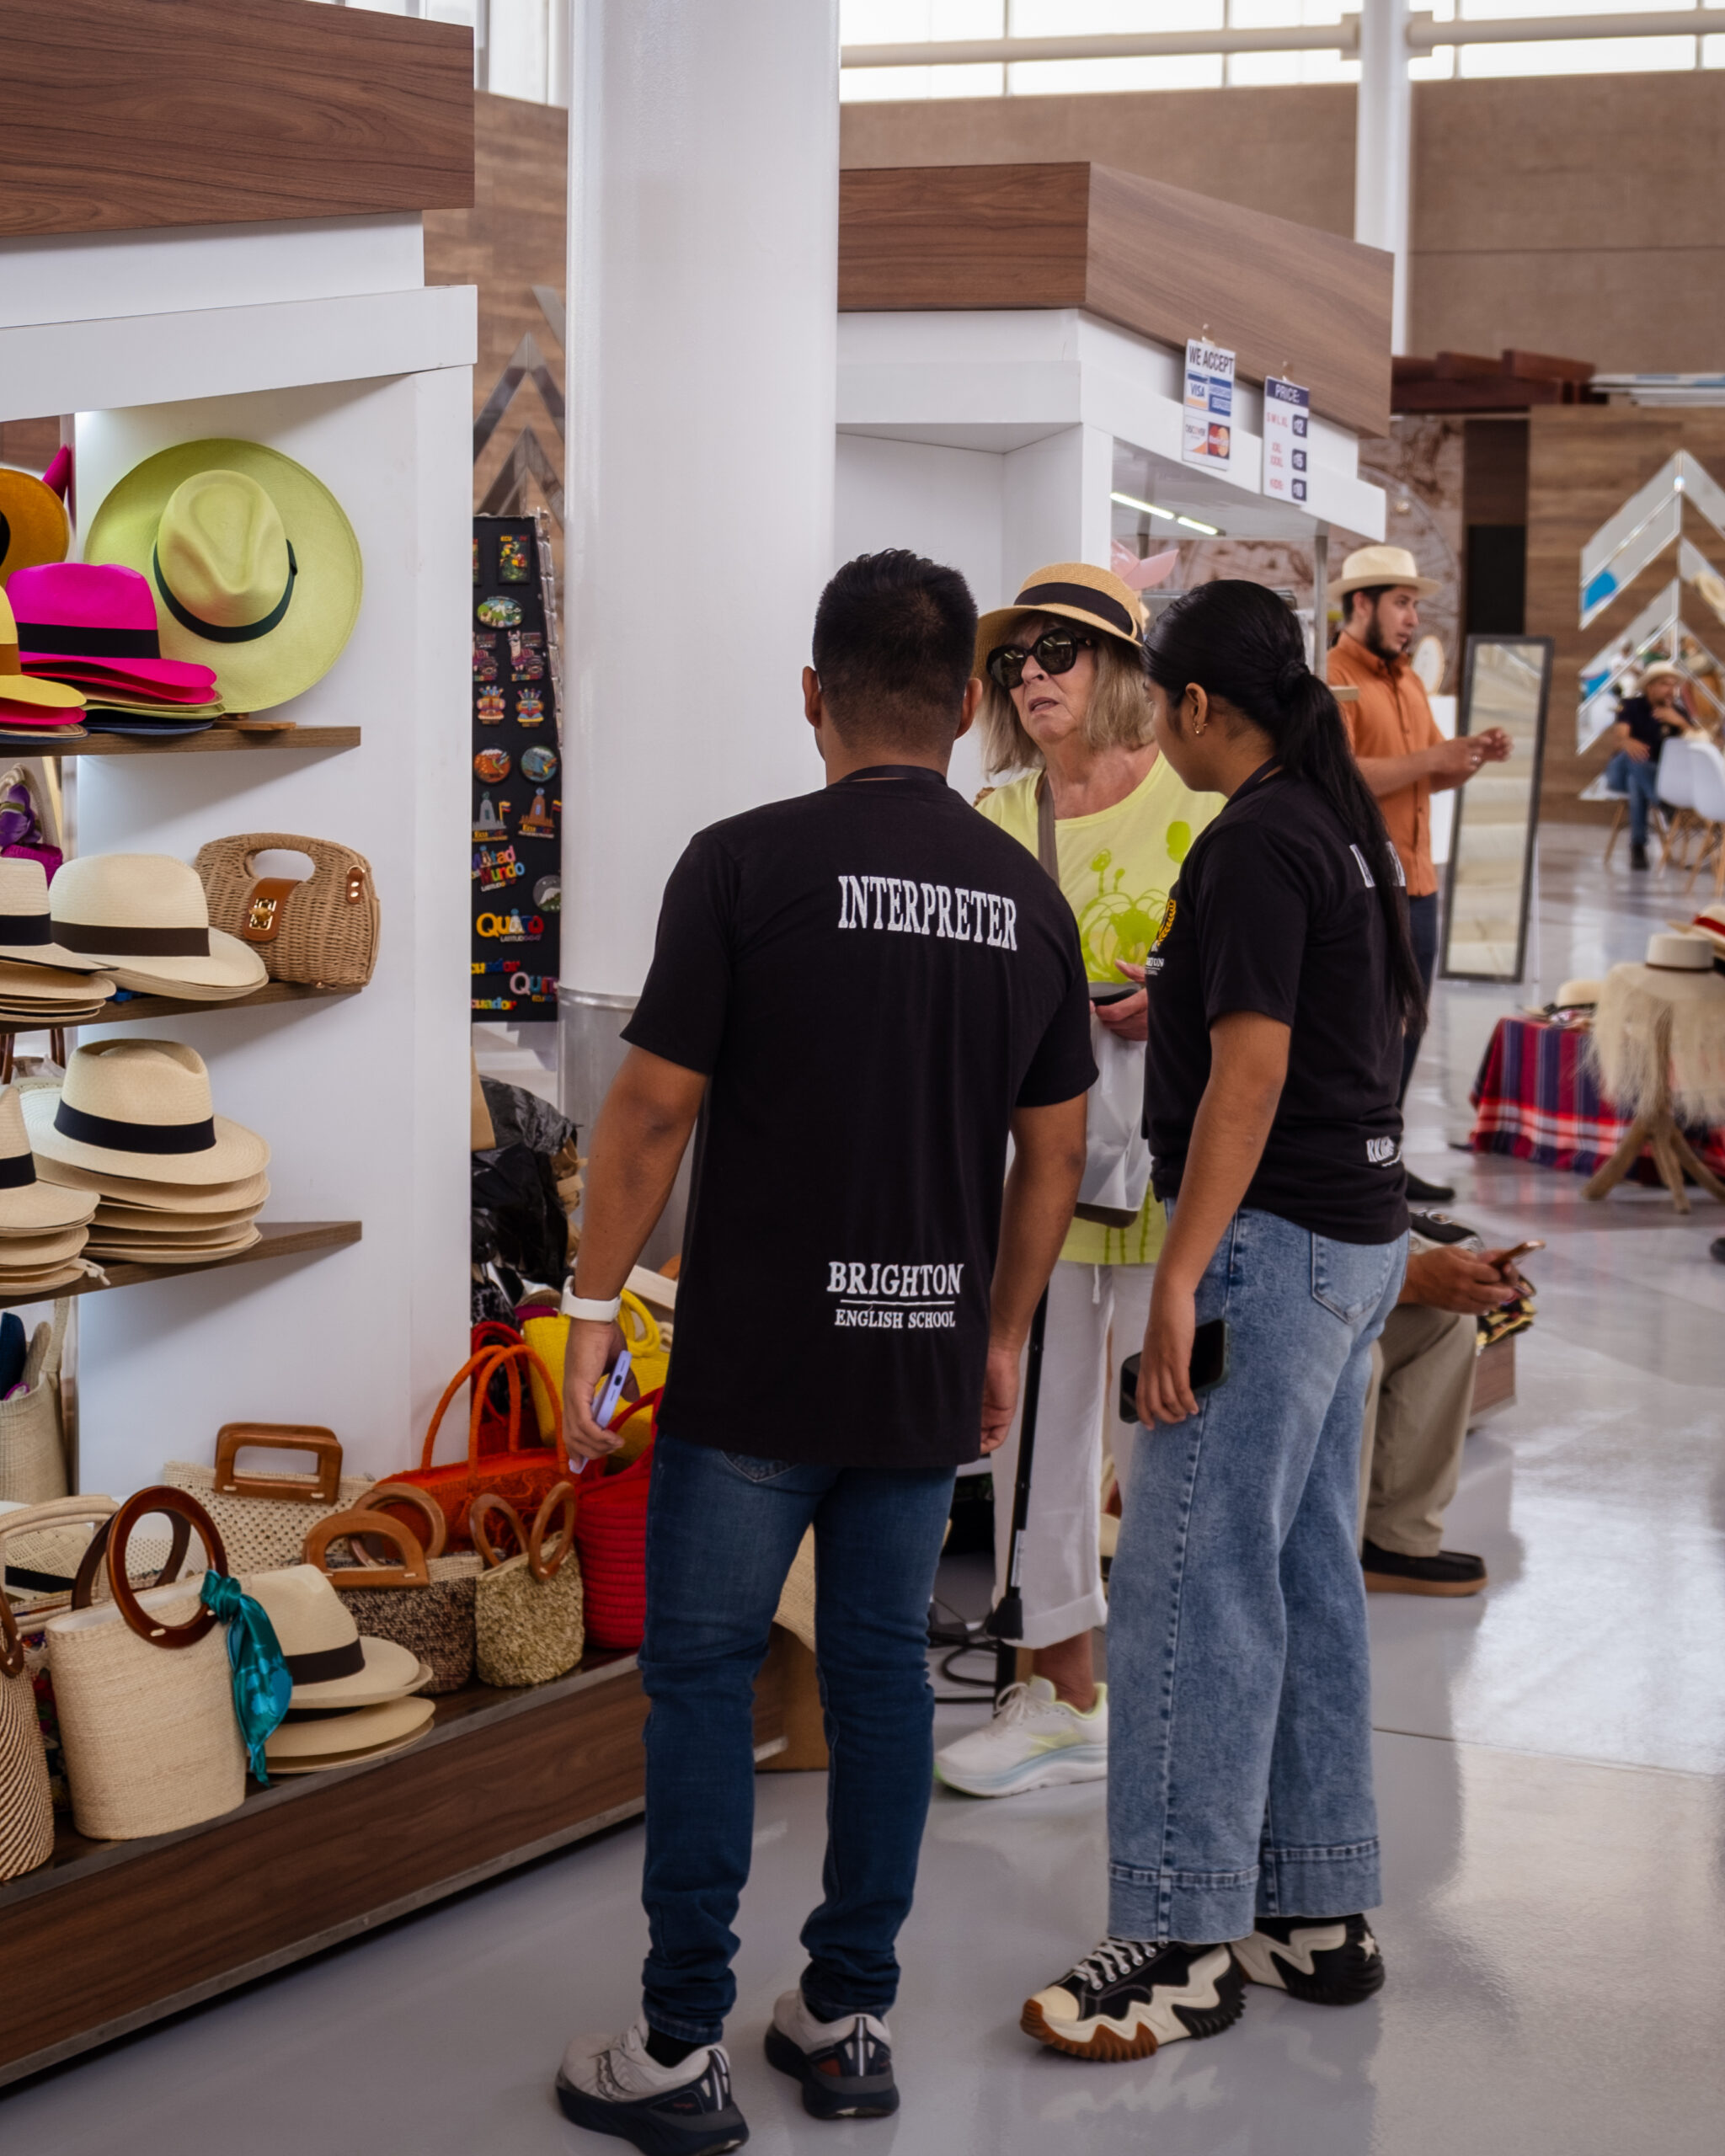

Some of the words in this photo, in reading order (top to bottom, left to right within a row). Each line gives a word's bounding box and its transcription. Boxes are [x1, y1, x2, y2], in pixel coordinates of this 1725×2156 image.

[1188, 345, 1201, 366] WE
[1203, 350, 1235, 374] ACCEPT
[1190, 382, 1205, 398] VISA
[479, 862, 526, 886] Mundo
[838, 875, 1017, 951] INTERPRETER
[826, 1262, 964, 1297] BRIGHTON
[835, 1309, 904, 1329] ENGLISH
[908, 1311, 956, 1329] SCHOOL
